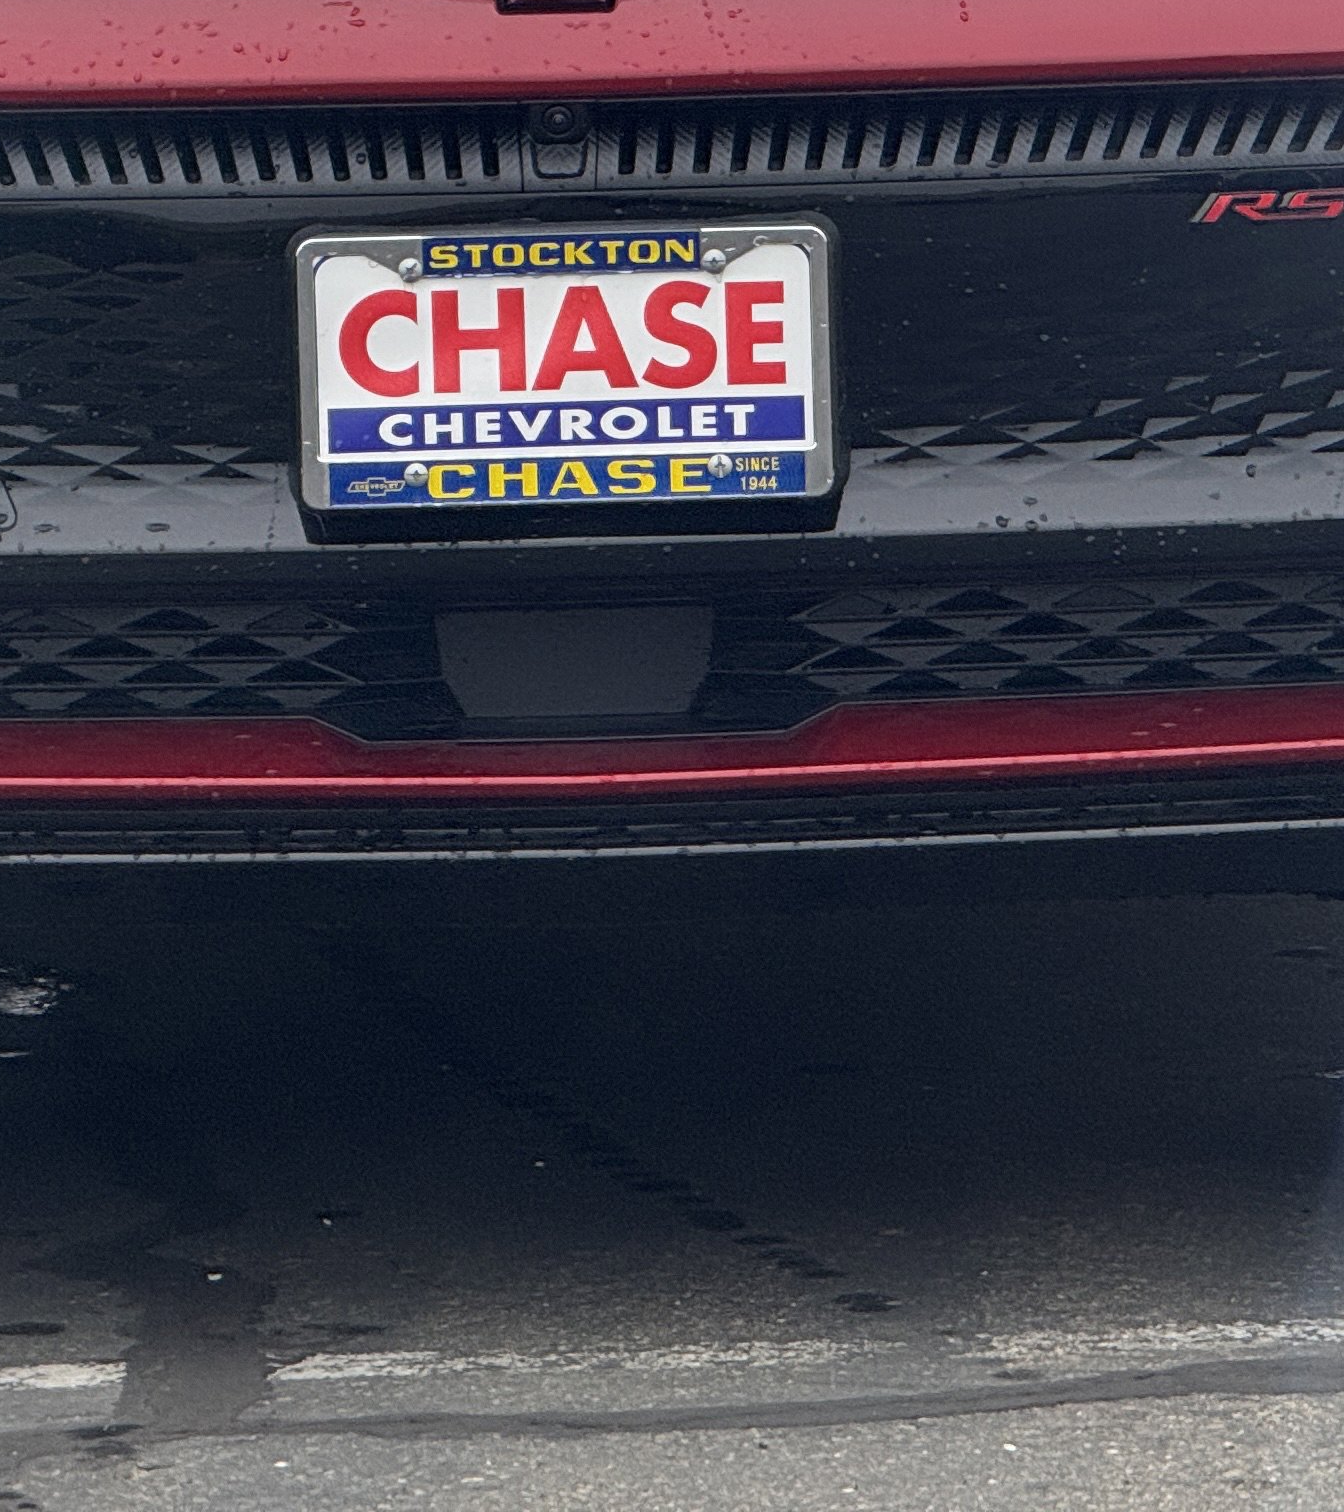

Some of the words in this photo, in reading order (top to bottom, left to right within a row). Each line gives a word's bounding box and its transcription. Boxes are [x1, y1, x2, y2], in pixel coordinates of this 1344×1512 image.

[429, 239, 694, 268] STOCKTON
[339, 280, 786, 397] CHASE
[379, 404, 755, 446] CHEVROLET
[428, 458, 712, 499] CHASE
[735, 456, 781, 472] SINCE
[740, 475, 778, 491] 1944
